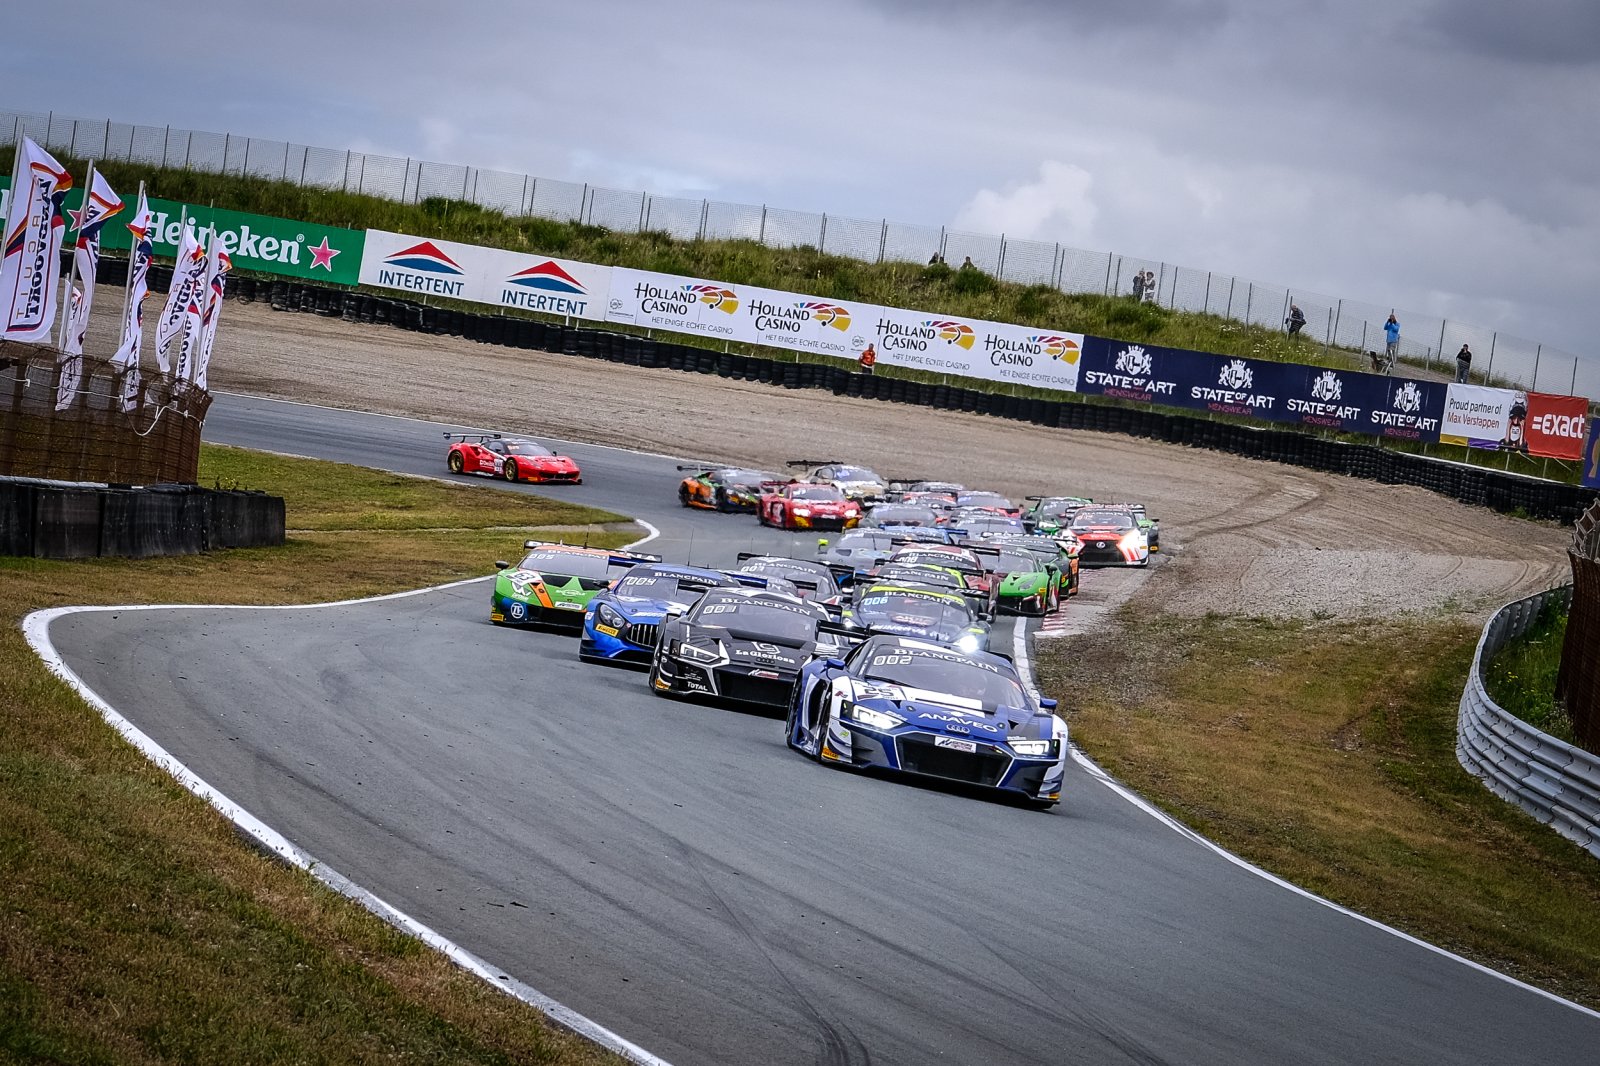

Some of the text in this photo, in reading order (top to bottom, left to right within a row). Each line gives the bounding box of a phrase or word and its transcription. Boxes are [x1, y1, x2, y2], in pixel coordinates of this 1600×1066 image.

[378, 269, 465, 296] INTERTENT
[634, 282, 697, 303] HOLLAND
[501, 289, 588, 316] INTERTENT
[641, 298, 688, 315] CASINO
[748, 299, 810, 321] HOLLAND
[651, 316, 665, 324] HET
[687, 321, 707, 330] ECHTE
[708, 324, 733, 334] CASINO
[755, 315, 801, 332] CASINO
[876, 318, 936, 340] HOLLAND
[765, 334, 779, 342] HET
[799, 338, 820, 348] ECHTE
[820, 341, 846, 352] CASINO
[882, 335, 927, 351] CASINO
[984, 333, 1042, 355] HOLLAND
[990, 350, 1034, 367] CASINO
[1085, 370, 1177, 395] STATE OF ART
[1191, 386, 1275, 409] STATE OF ART
[1449, 397, 1503, 415] Proud partner of
[1286, 398, 1361, 420] STATE OF ART
[1370, 410, 1438, 432] STATE OF ART
[1446, 411, 1500, 430] Max Verstappen
[653, 571, 718, 586] BLANCPAIN
[720, 597, 811, 616] BLANCPAIN
[863, 596, 888, 606] 006
[884, 591, 950, 605] BLANCPAIN
[512, 604, 523, 616] ZF
[873, 655, 912, 666] 002
[893, 648, 999, 673] BLANCPAIN
[687, 681, 709, 692] TOTAL
[918, 712, 998, 733] ANAVEO
